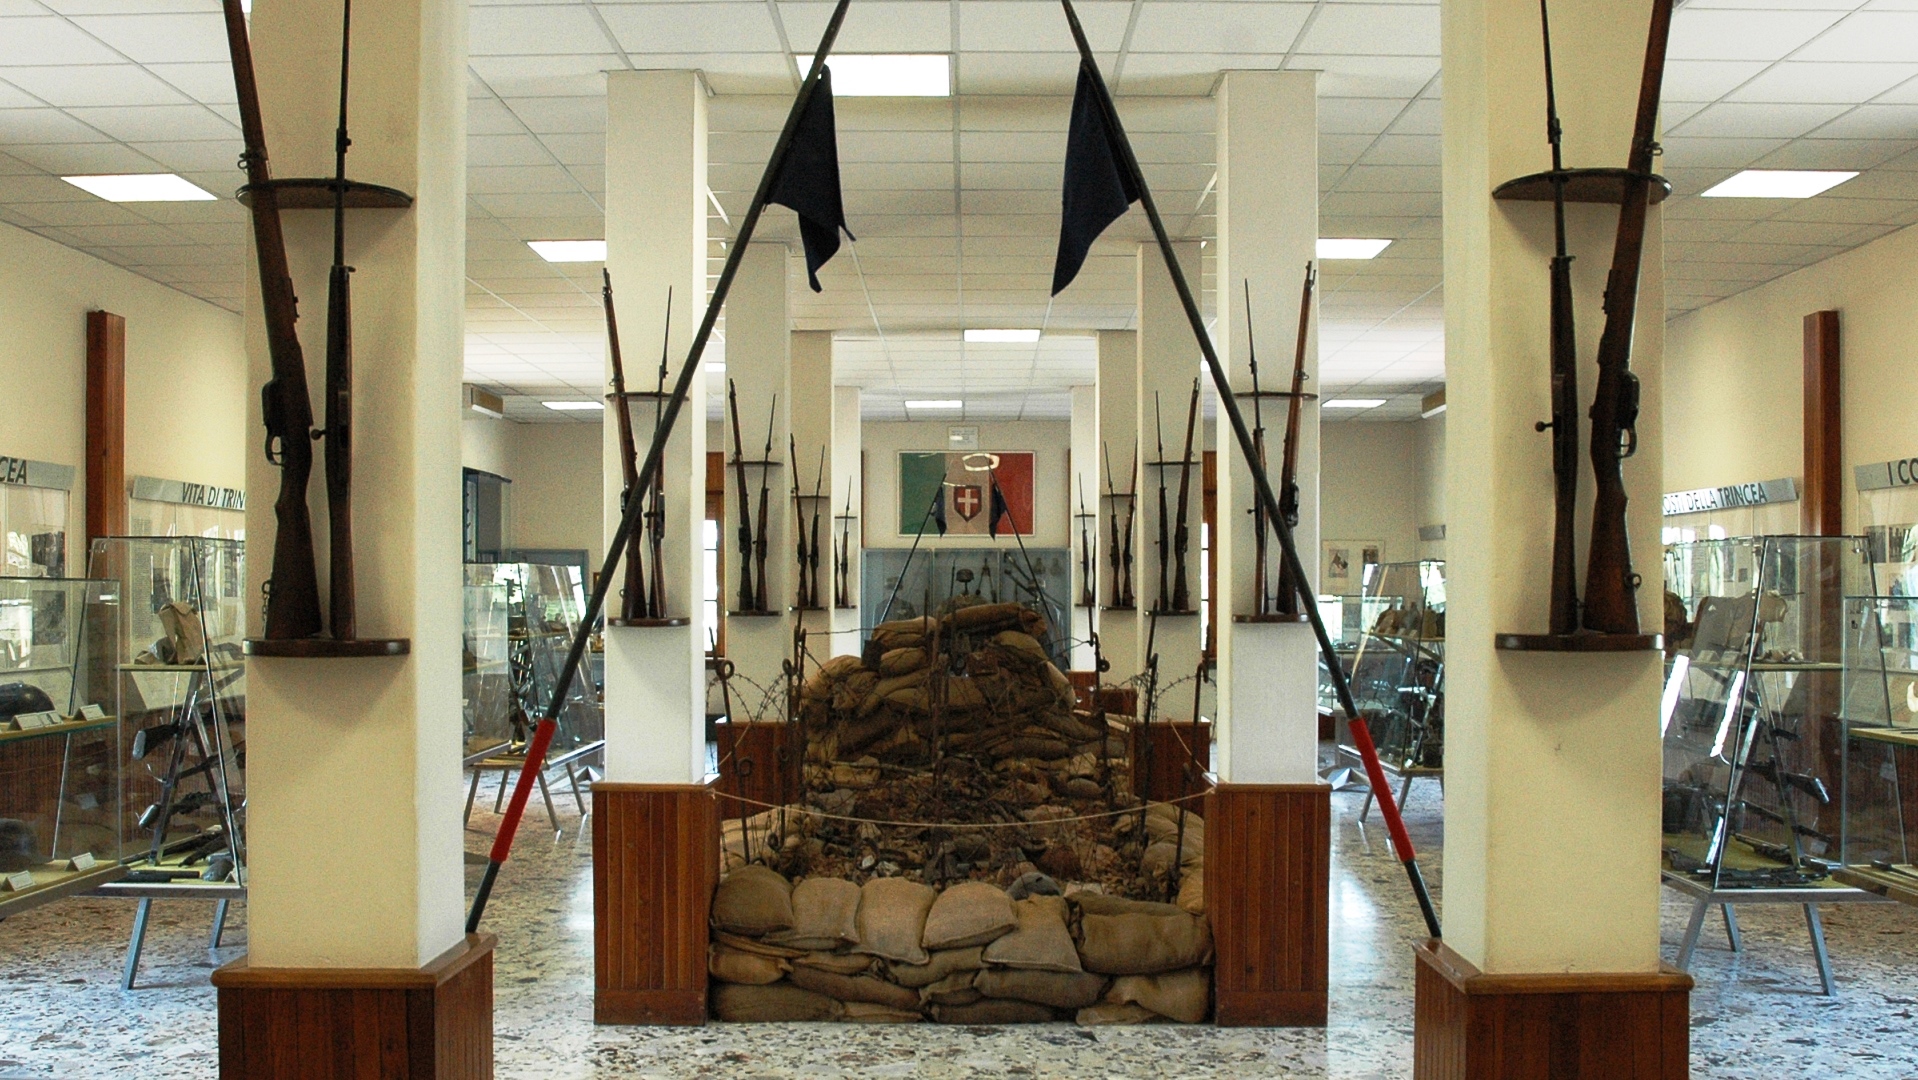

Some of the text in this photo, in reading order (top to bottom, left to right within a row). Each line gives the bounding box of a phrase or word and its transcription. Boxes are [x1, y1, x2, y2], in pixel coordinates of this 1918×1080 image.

[1887, 461, 1894, 486] I
[182, 482, 205, 505] VITA
[207, 486, 220, 506] DI
[1686, 490, 1718, 511] DELLA
[1717, 482, 1768, 508] TRINCEA
